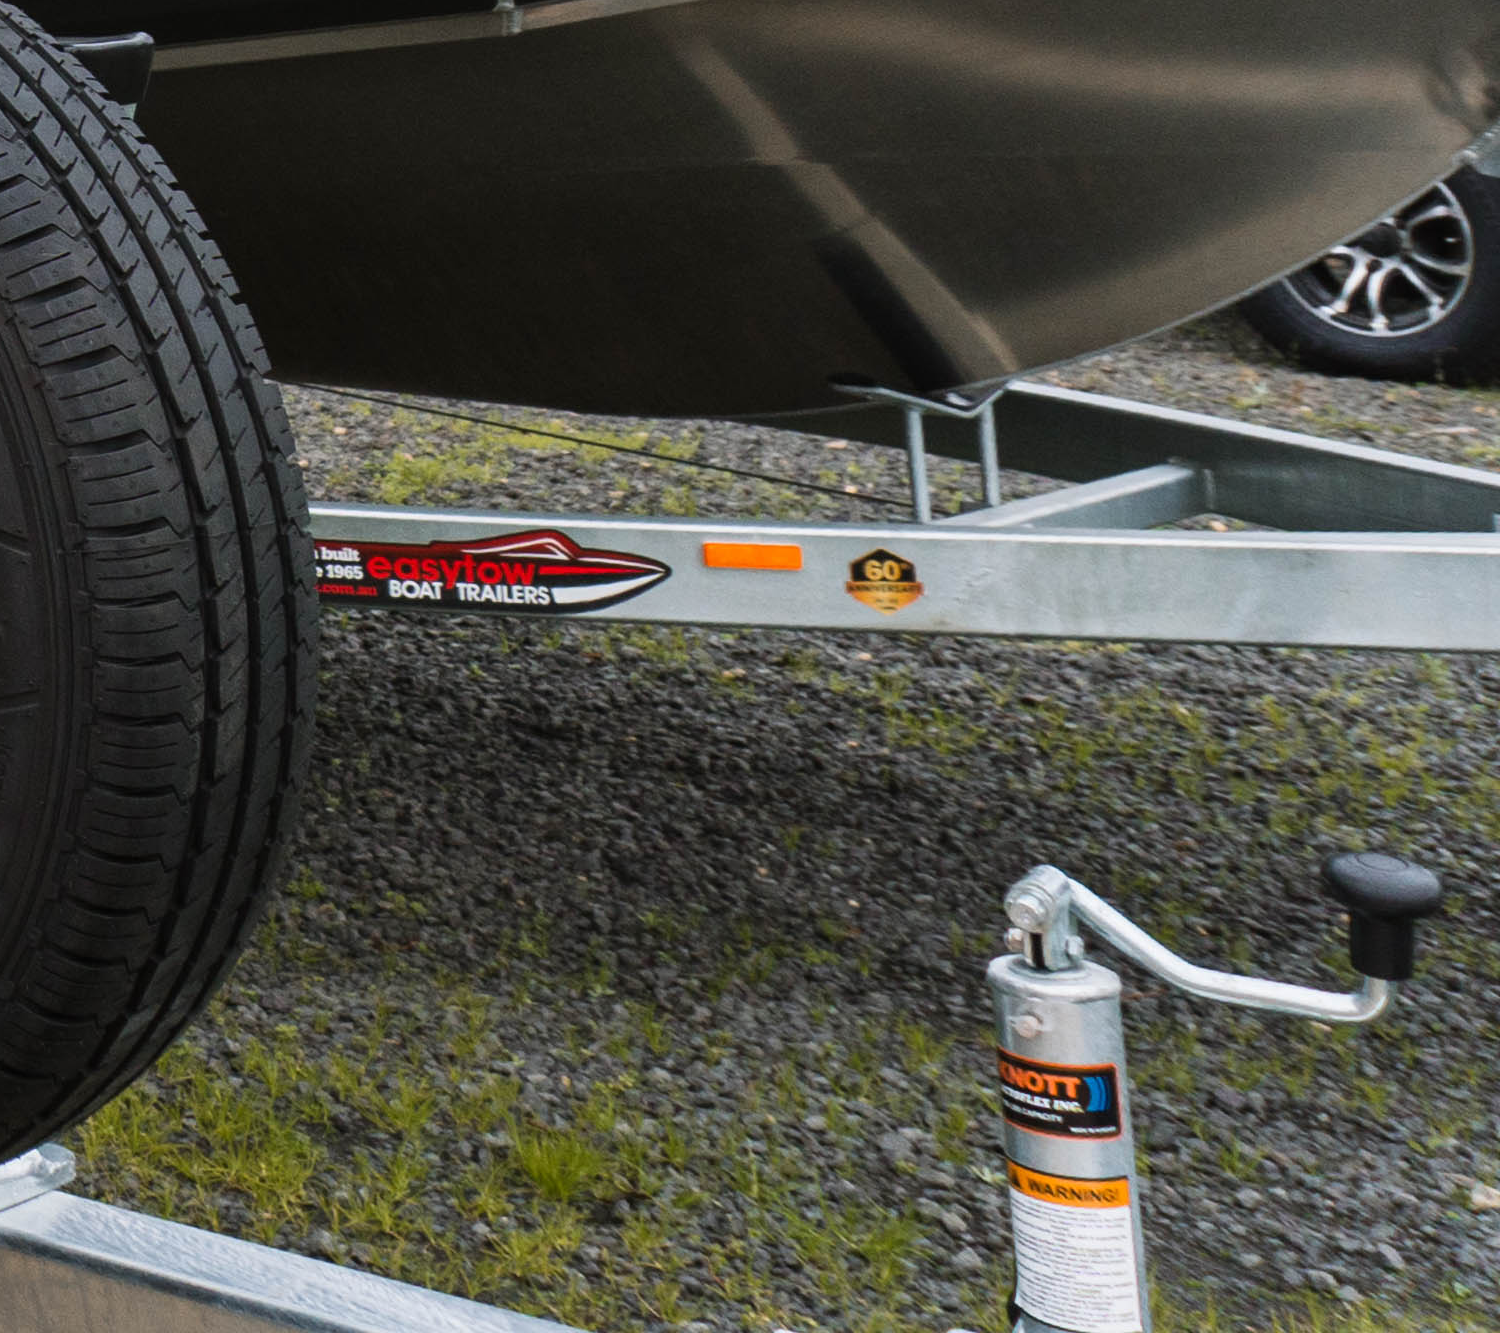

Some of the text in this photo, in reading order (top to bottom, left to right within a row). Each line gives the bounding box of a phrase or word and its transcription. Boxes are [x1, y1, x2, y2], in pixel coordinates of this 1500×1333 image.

[322, 547, 361, 563] built
[326, 564, 364, 580] 1965
[366, 553, 536, 589] easytow
[389, 579, 443, 600] BOAT
[457, 584, 551, 605] TRAILERS
[1028, 1178, 1119, 1202] WARNING!
